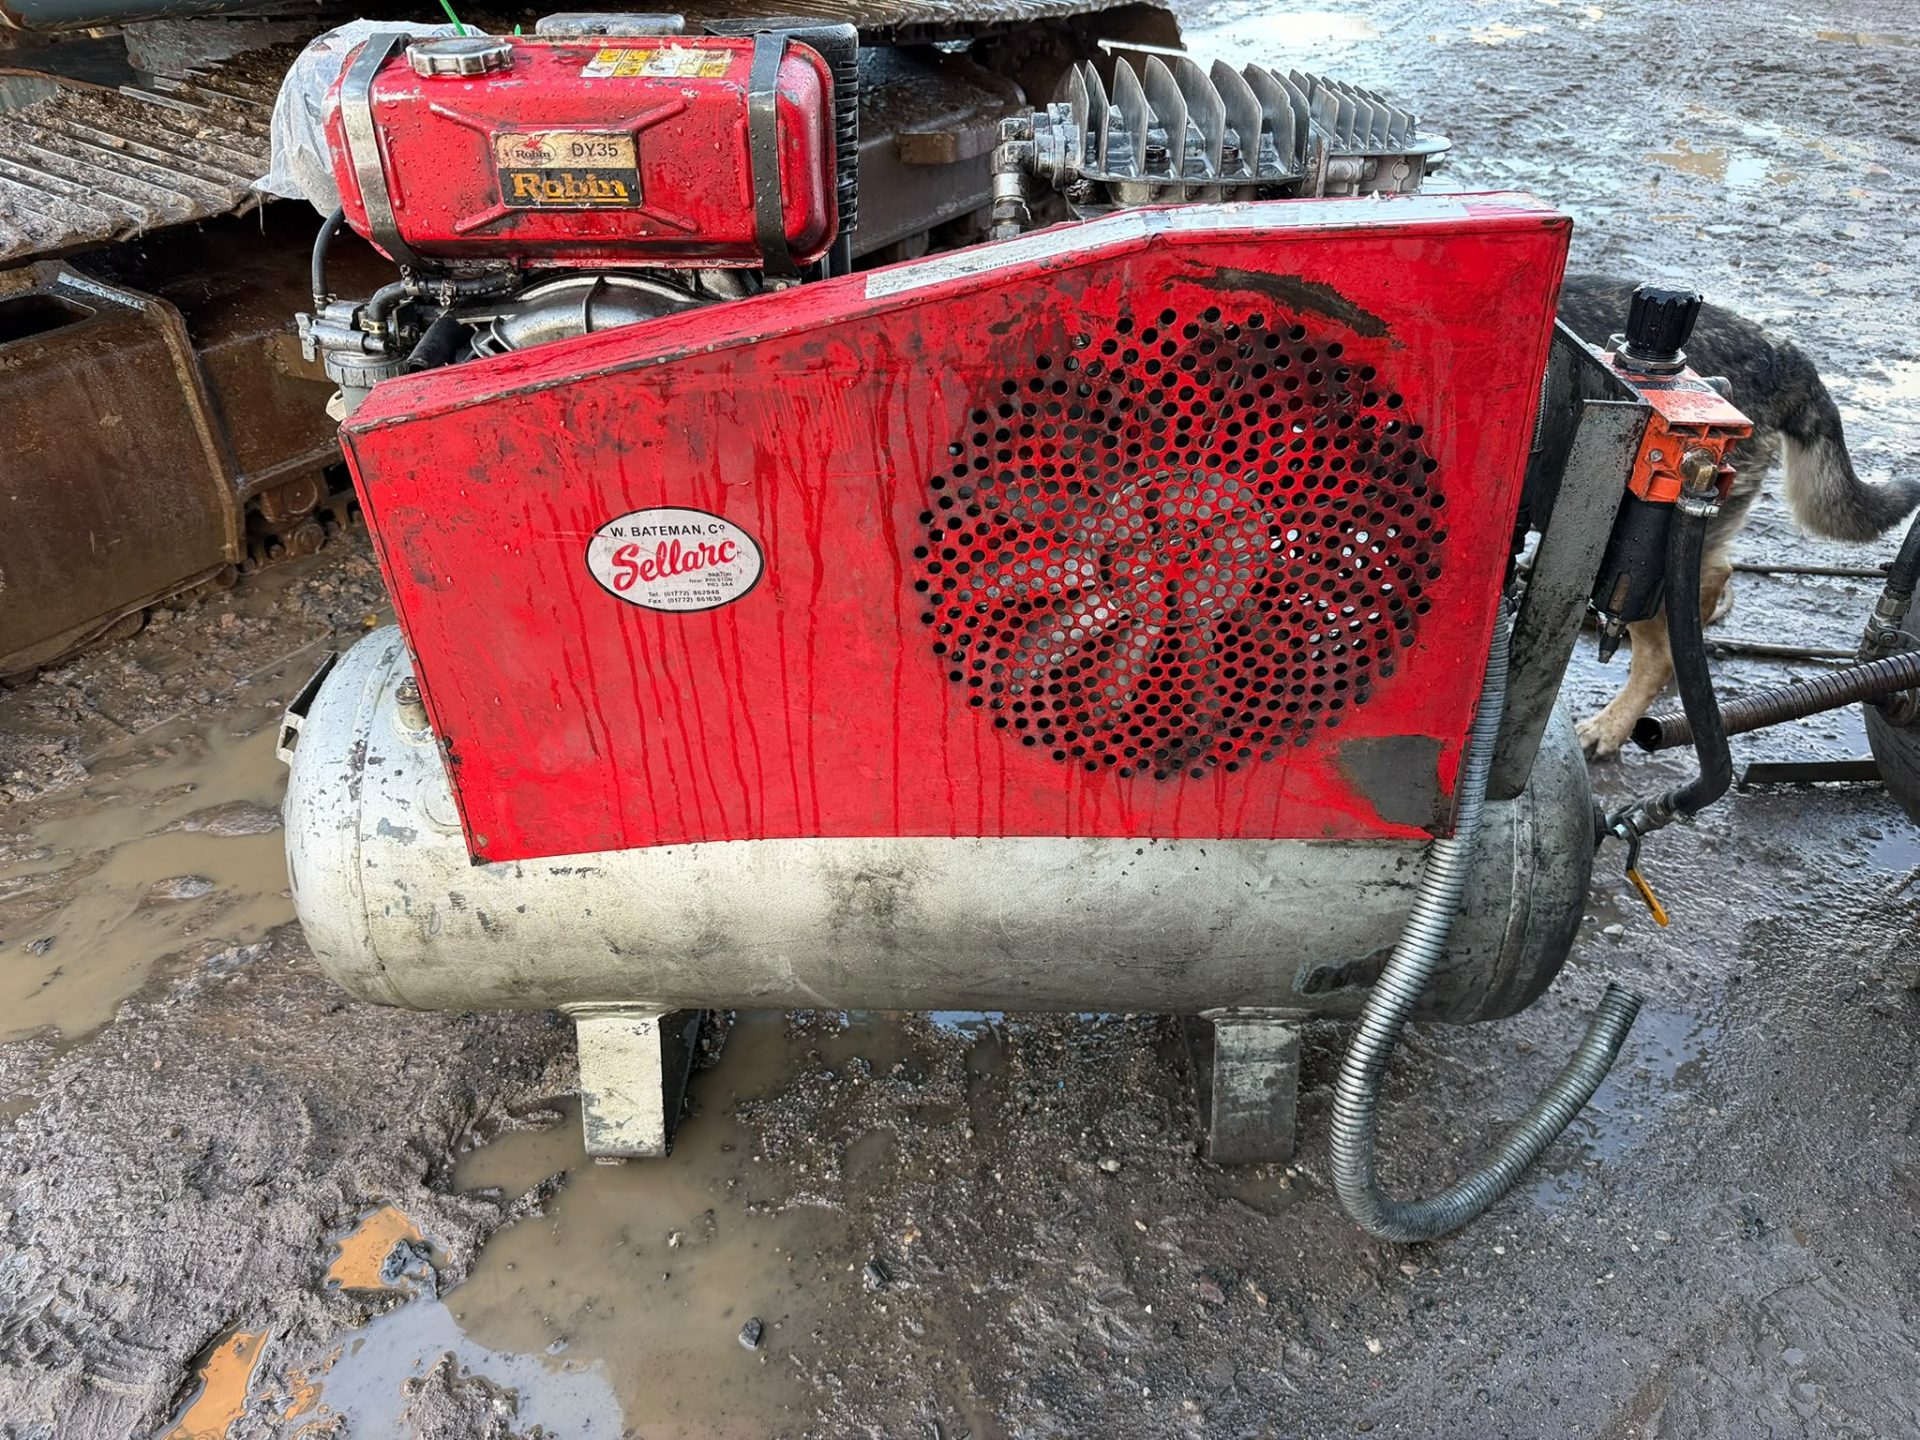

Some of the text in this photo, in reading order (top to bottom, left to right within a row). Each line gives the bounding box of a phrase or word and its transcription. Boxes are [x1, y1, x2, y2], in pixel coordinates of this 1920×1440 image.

[515, 149, 551, 160] Robin
[571, 143, 618, 157] DY35
[510, 172, 629, 199] Robin
[610, 527, 627, 537] W.
[631, 525, 706, 537] BATEMAN,
[611, 538, 737, 592] Sellarc
[664, 590, 690, 598] (01772)
[667, 596, 693, 604] (01772)
